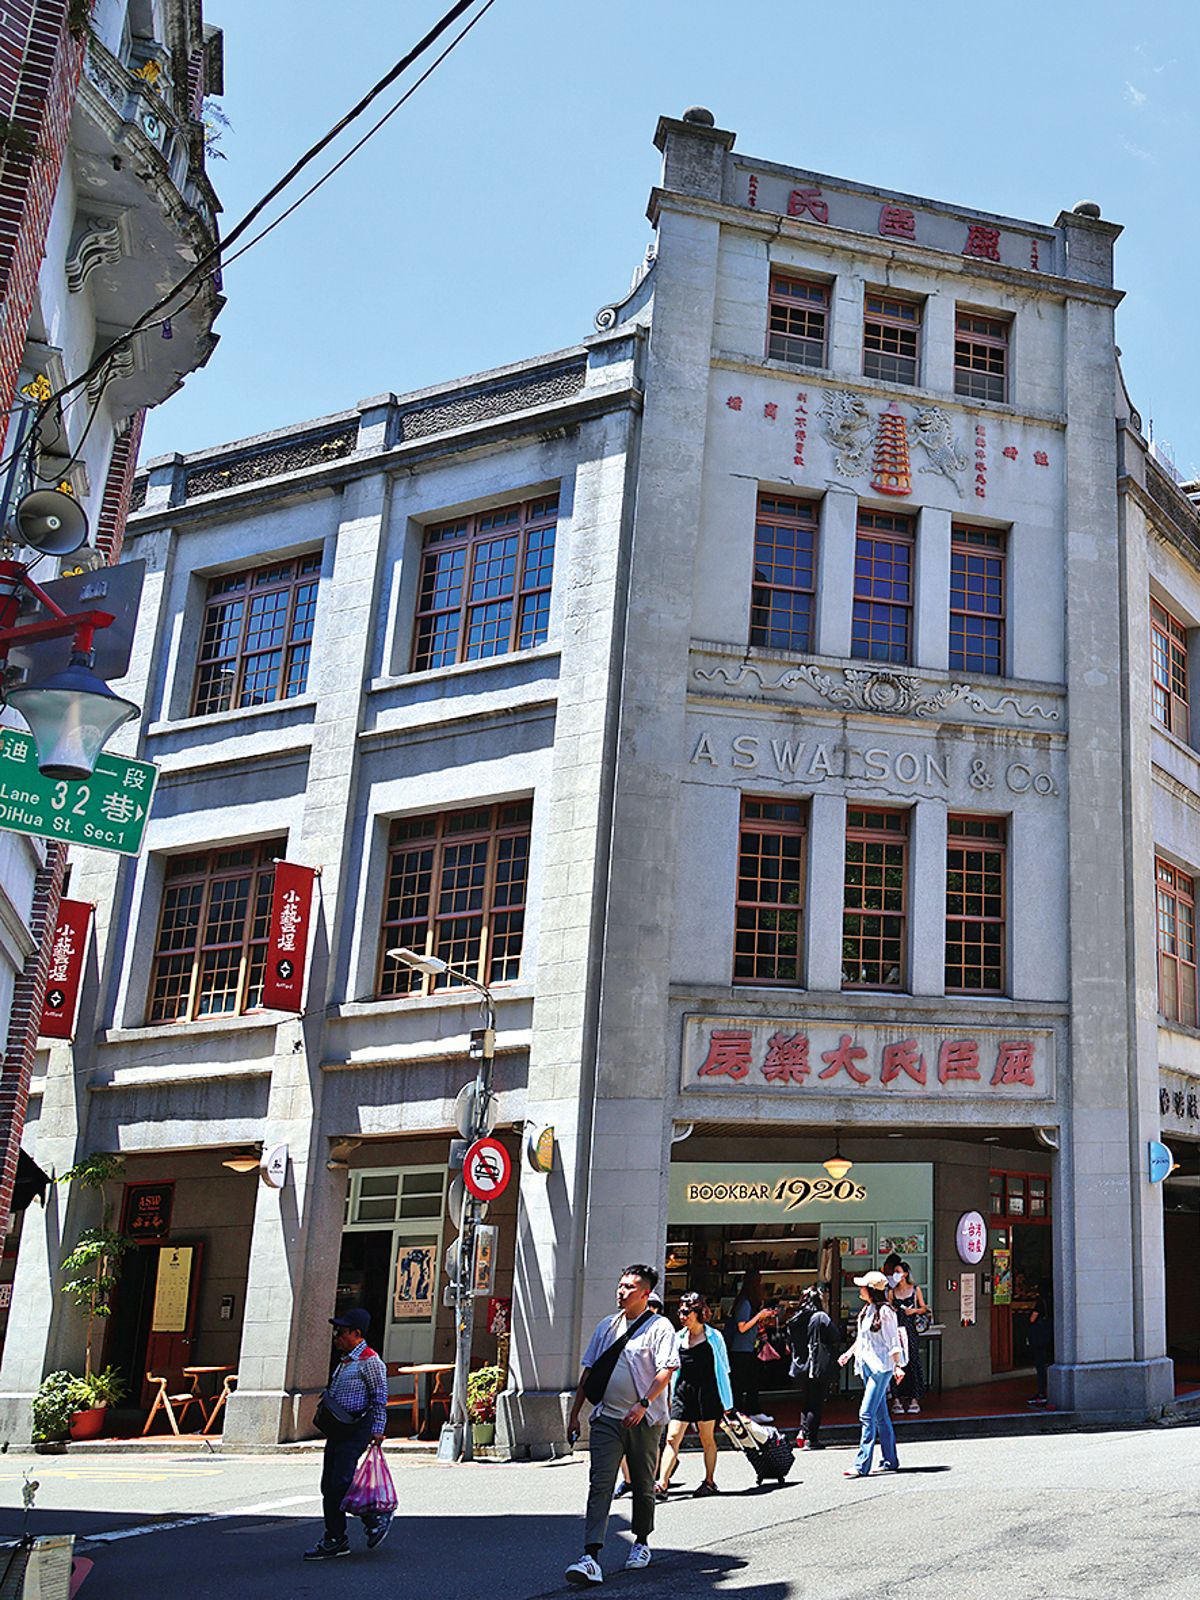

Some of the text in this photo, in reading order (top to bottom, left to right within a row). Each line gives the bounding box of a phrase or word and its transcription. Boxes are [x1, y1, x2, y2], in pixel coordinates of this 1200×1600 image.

[769, 737, 952, 789] WATSON
[968, 757, 996, 791] &
[1, 781, 90, 816] Lane 32
[101, 792, 134, 824] 巷
[53, 816, 73, 834] St.
[689, 1178, 867, 1212] BOOKBAR 1920s
